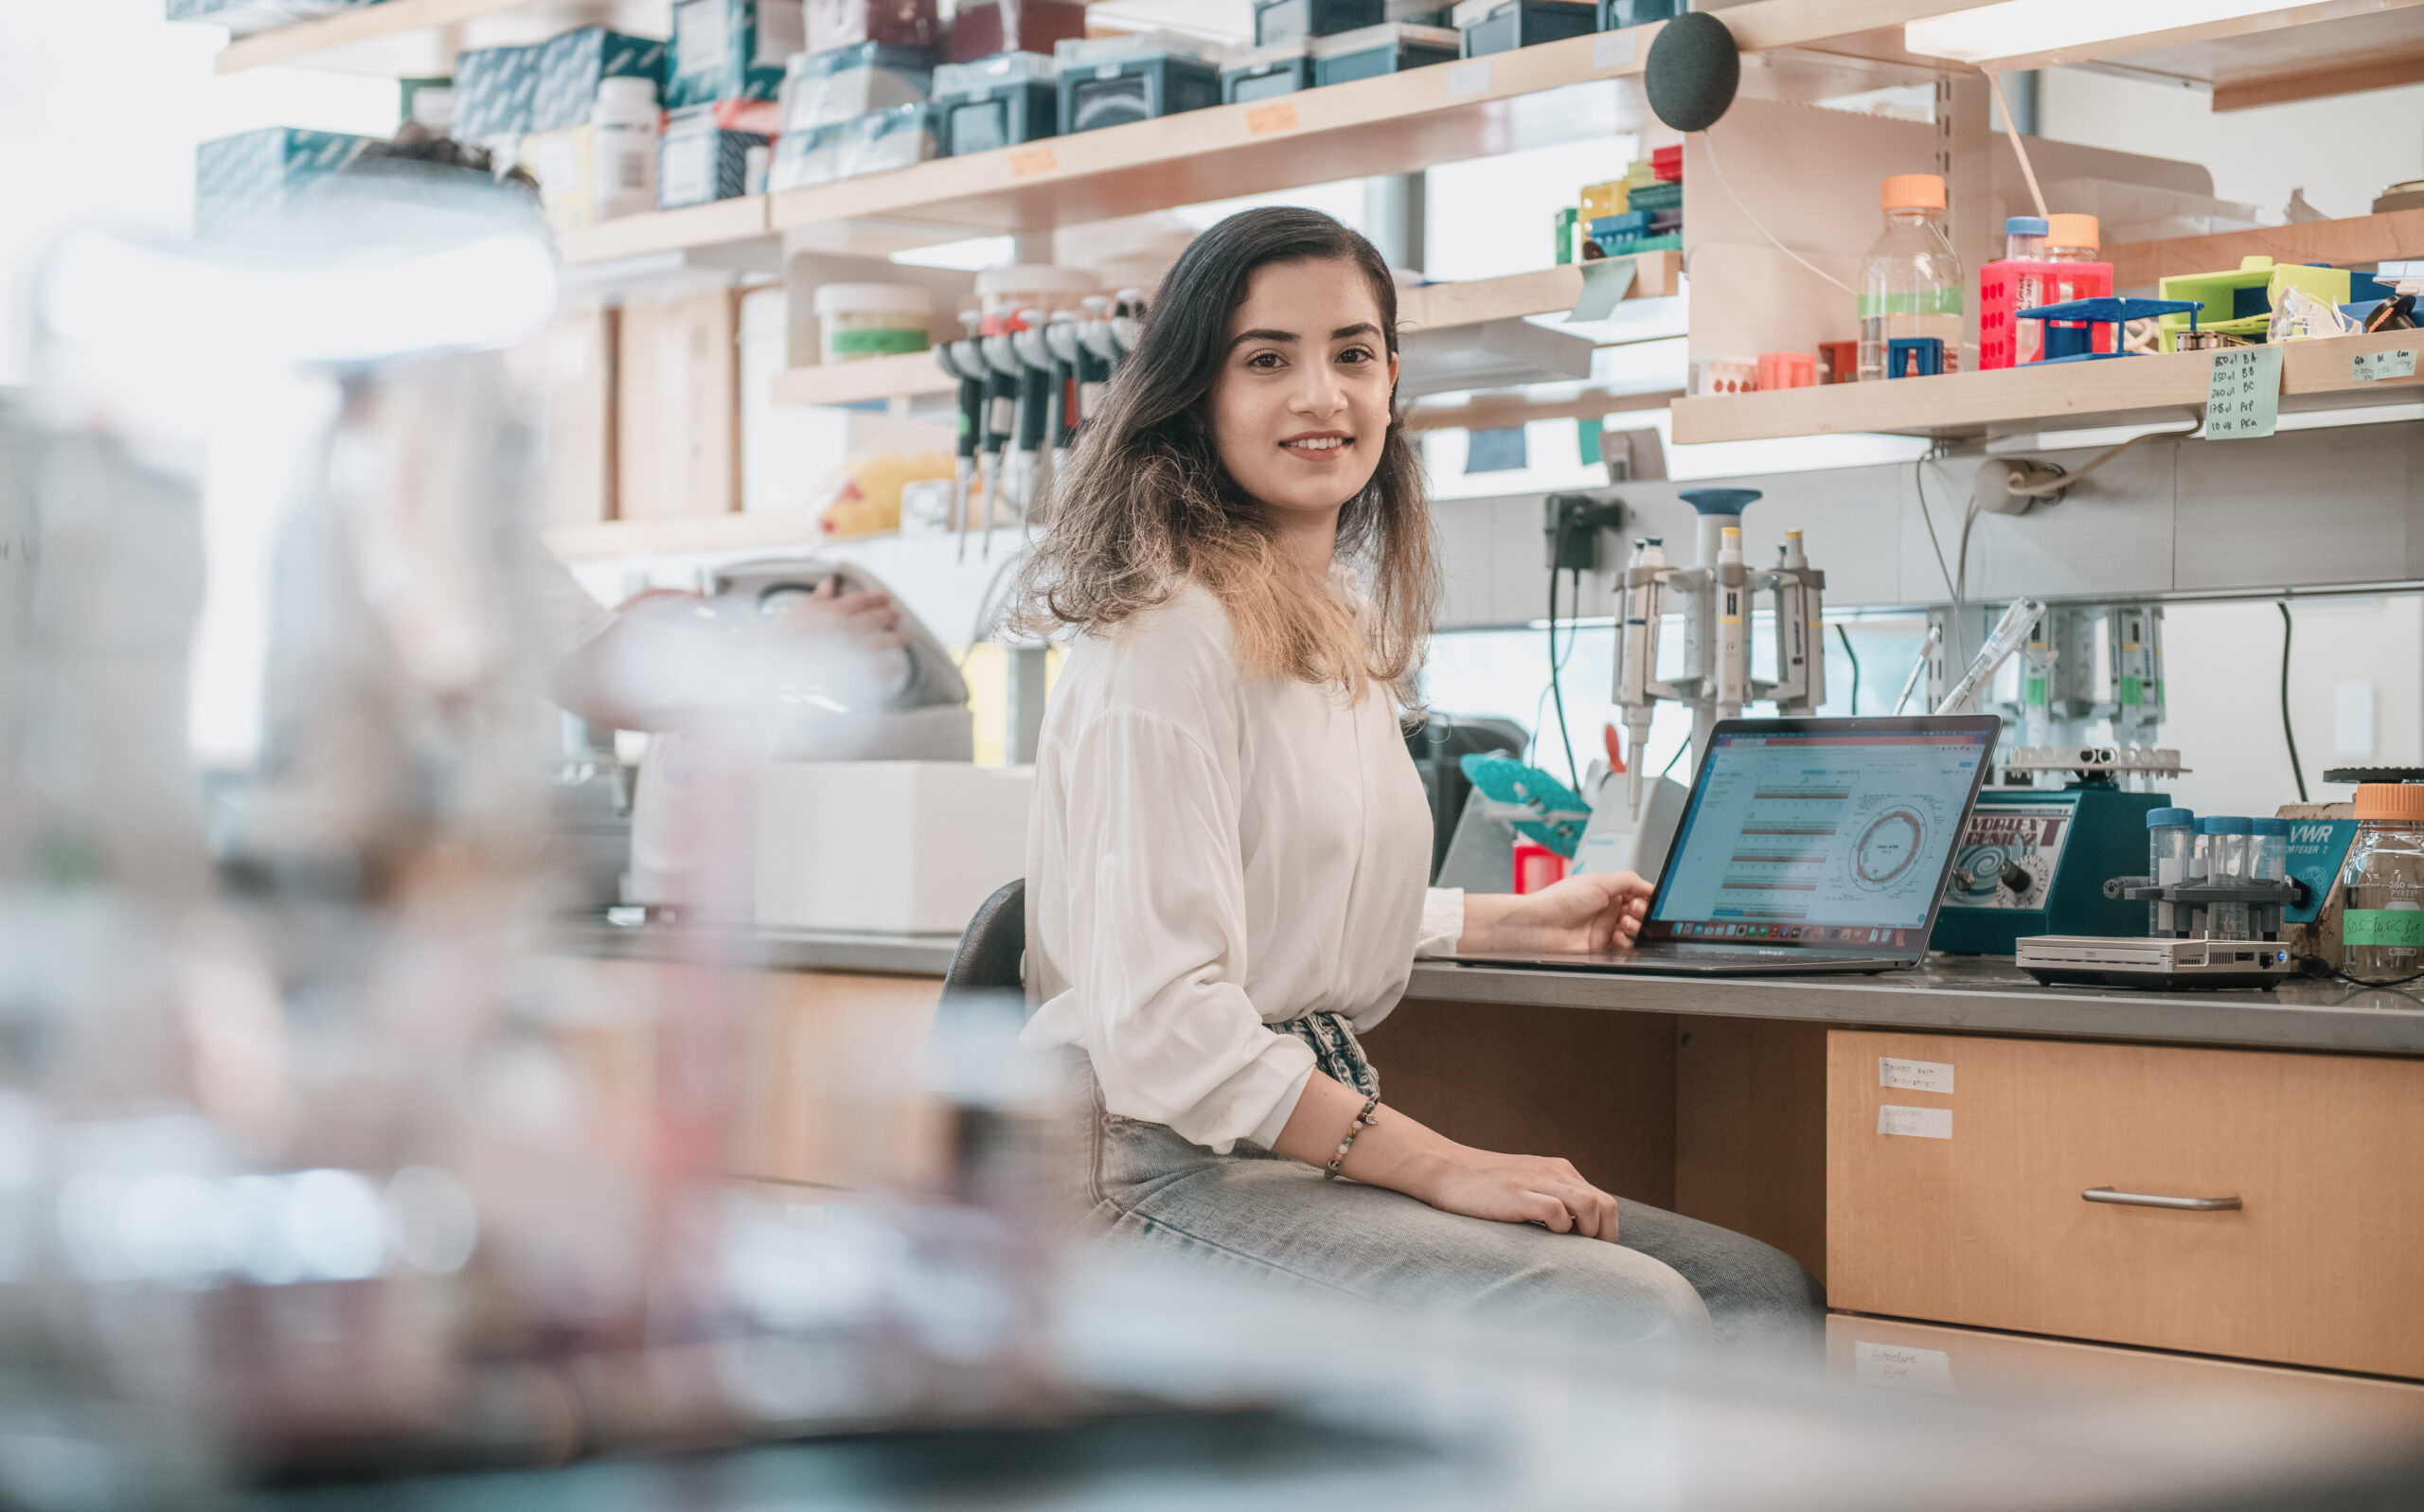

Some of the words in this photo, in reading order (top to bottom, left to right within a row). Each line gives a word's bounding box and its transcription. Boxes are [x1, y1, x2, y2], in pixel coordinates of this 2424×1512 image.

[1970, 818, 2041, 831] VORTEX
[2290, 825, 2334, 843] VWR
[2285, 845, 2320, 855] ORTEXER
